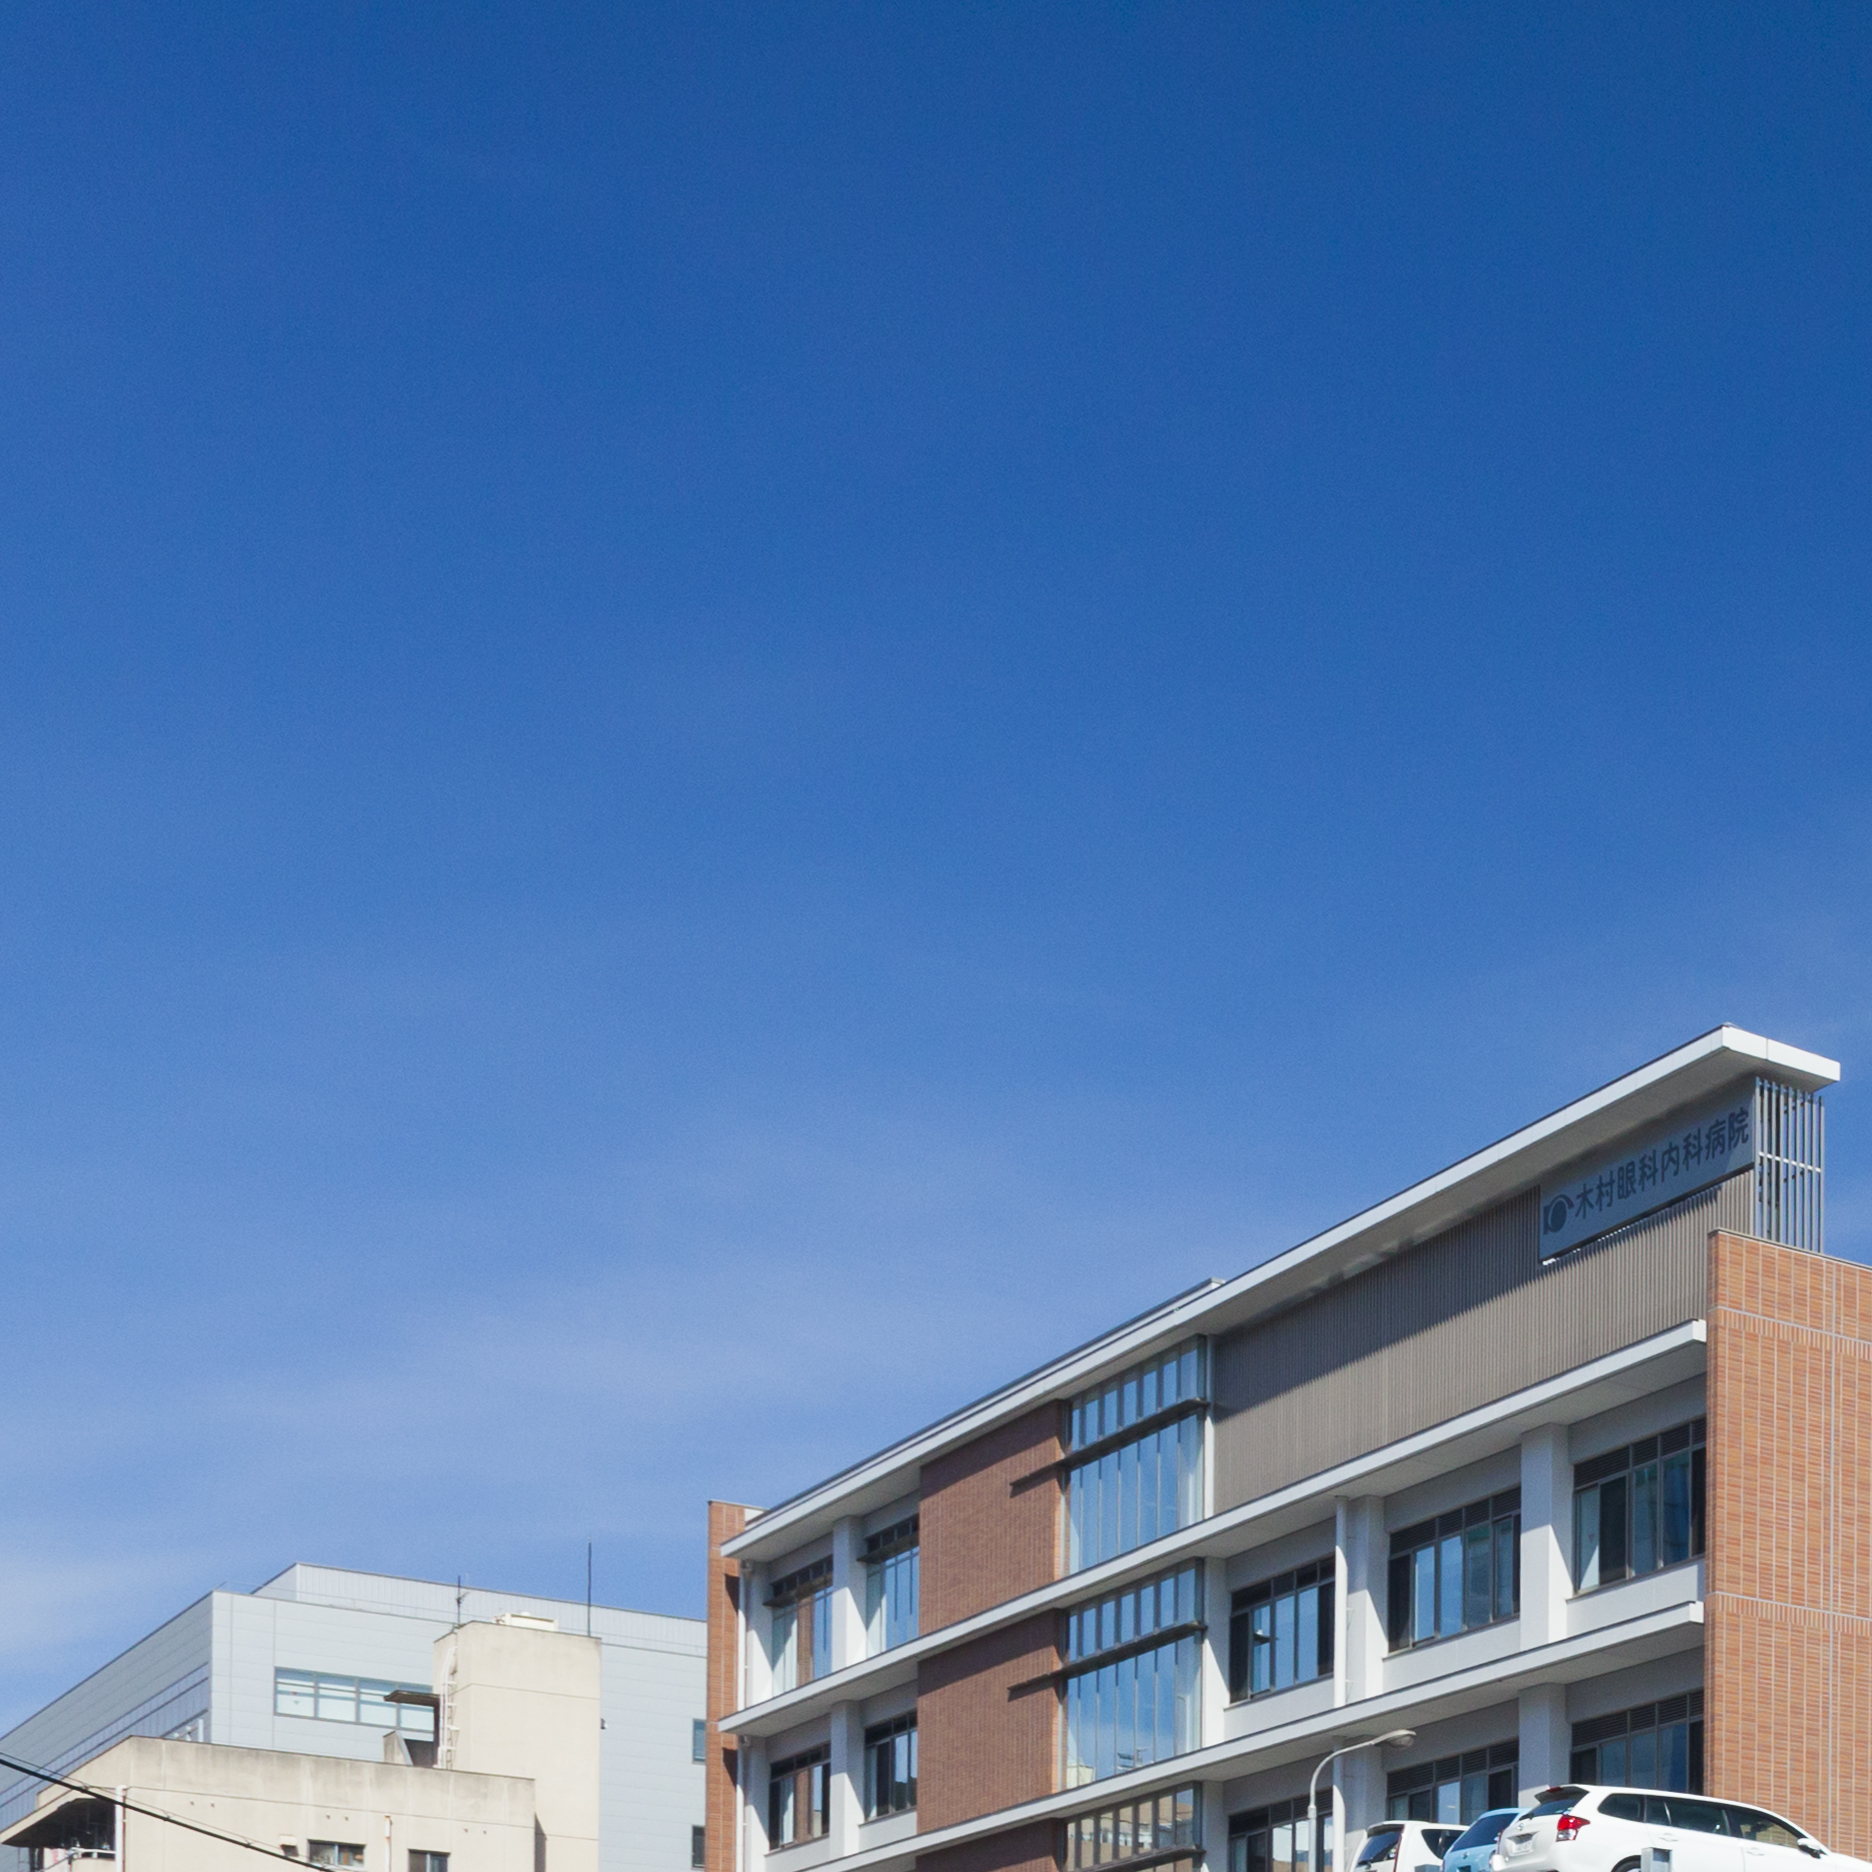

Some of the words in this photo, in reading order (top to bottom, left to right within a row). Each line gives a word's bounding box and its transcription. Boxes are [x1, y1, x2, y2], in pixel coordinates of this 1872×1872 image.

[1575, 1108, 1749, 1220] 木村眼科内科病院
